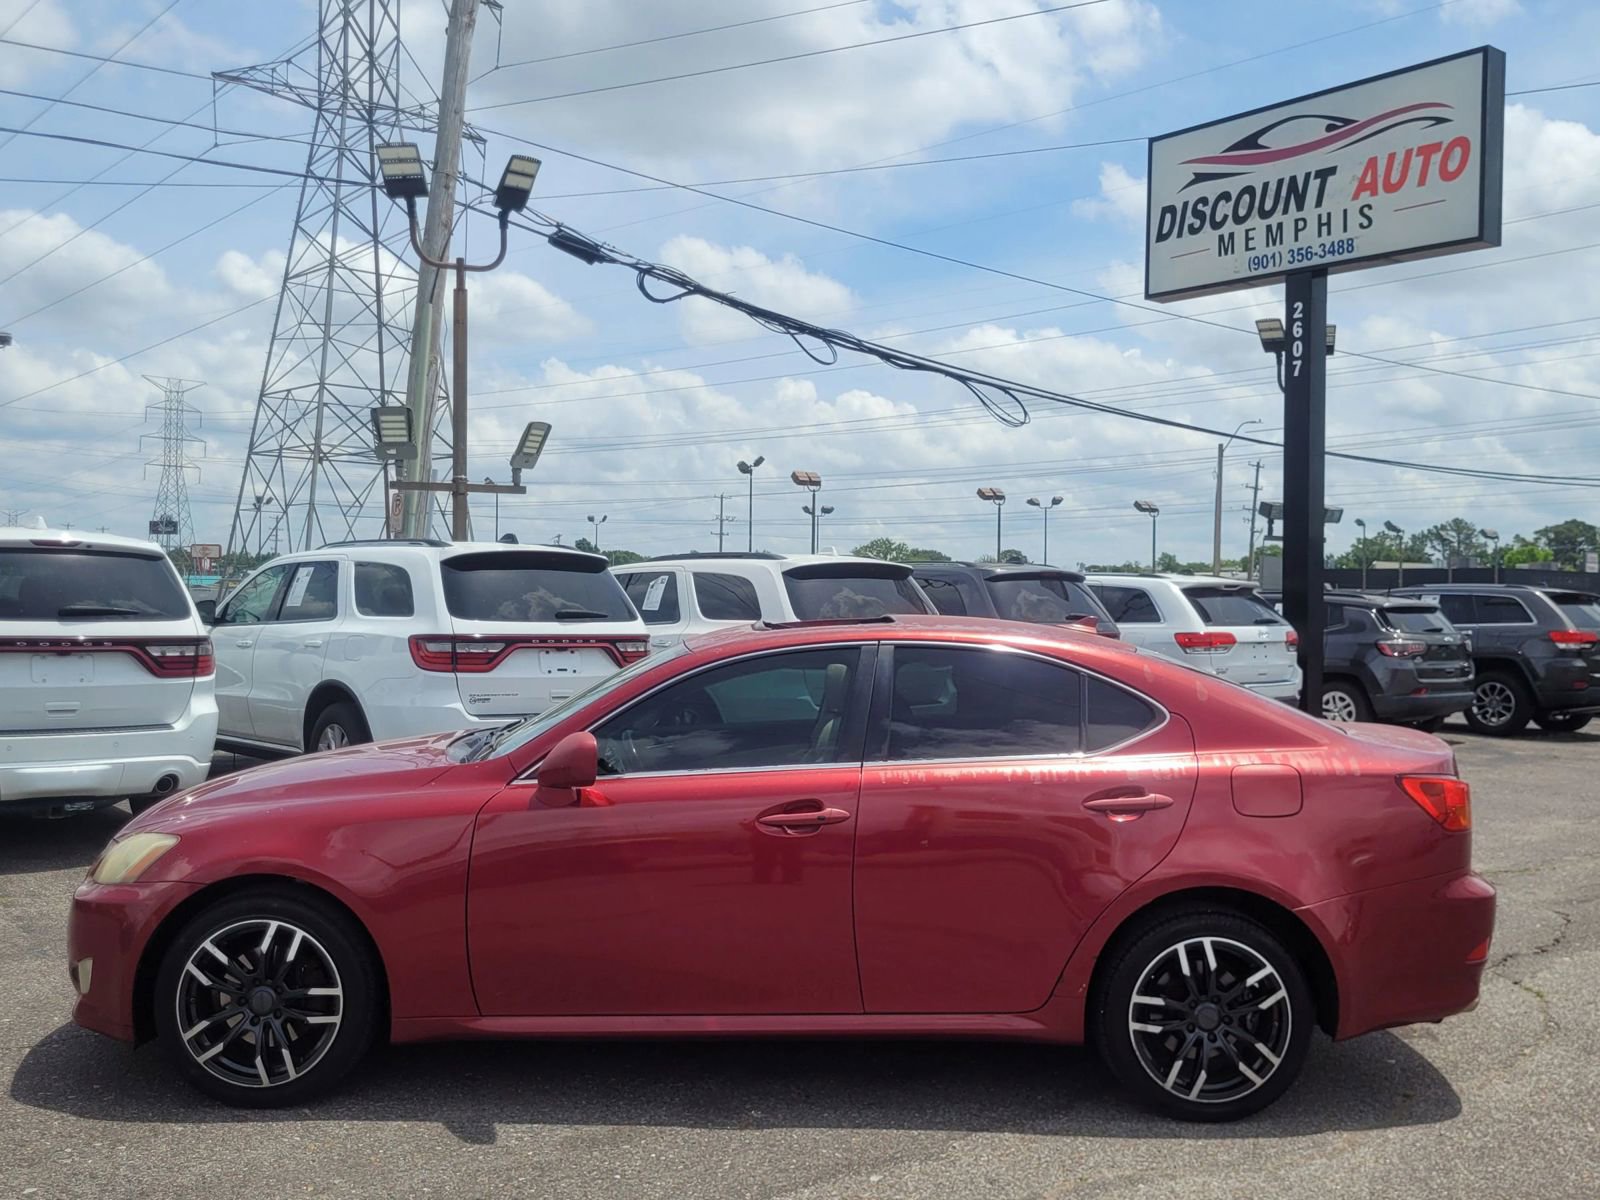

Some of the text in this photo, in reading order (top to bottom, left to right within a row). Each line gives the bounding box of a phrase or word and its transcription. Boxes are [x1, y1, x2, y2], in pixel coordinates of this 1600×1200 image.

[1155, 136, 1471, 243] DISCOUNT AUTO
[1217, 204, 1373, 257] MEMPHIS
[1247, 238, 1355, 272] (901) 356-3488
[1292, 301, 1303, 377] 2607
